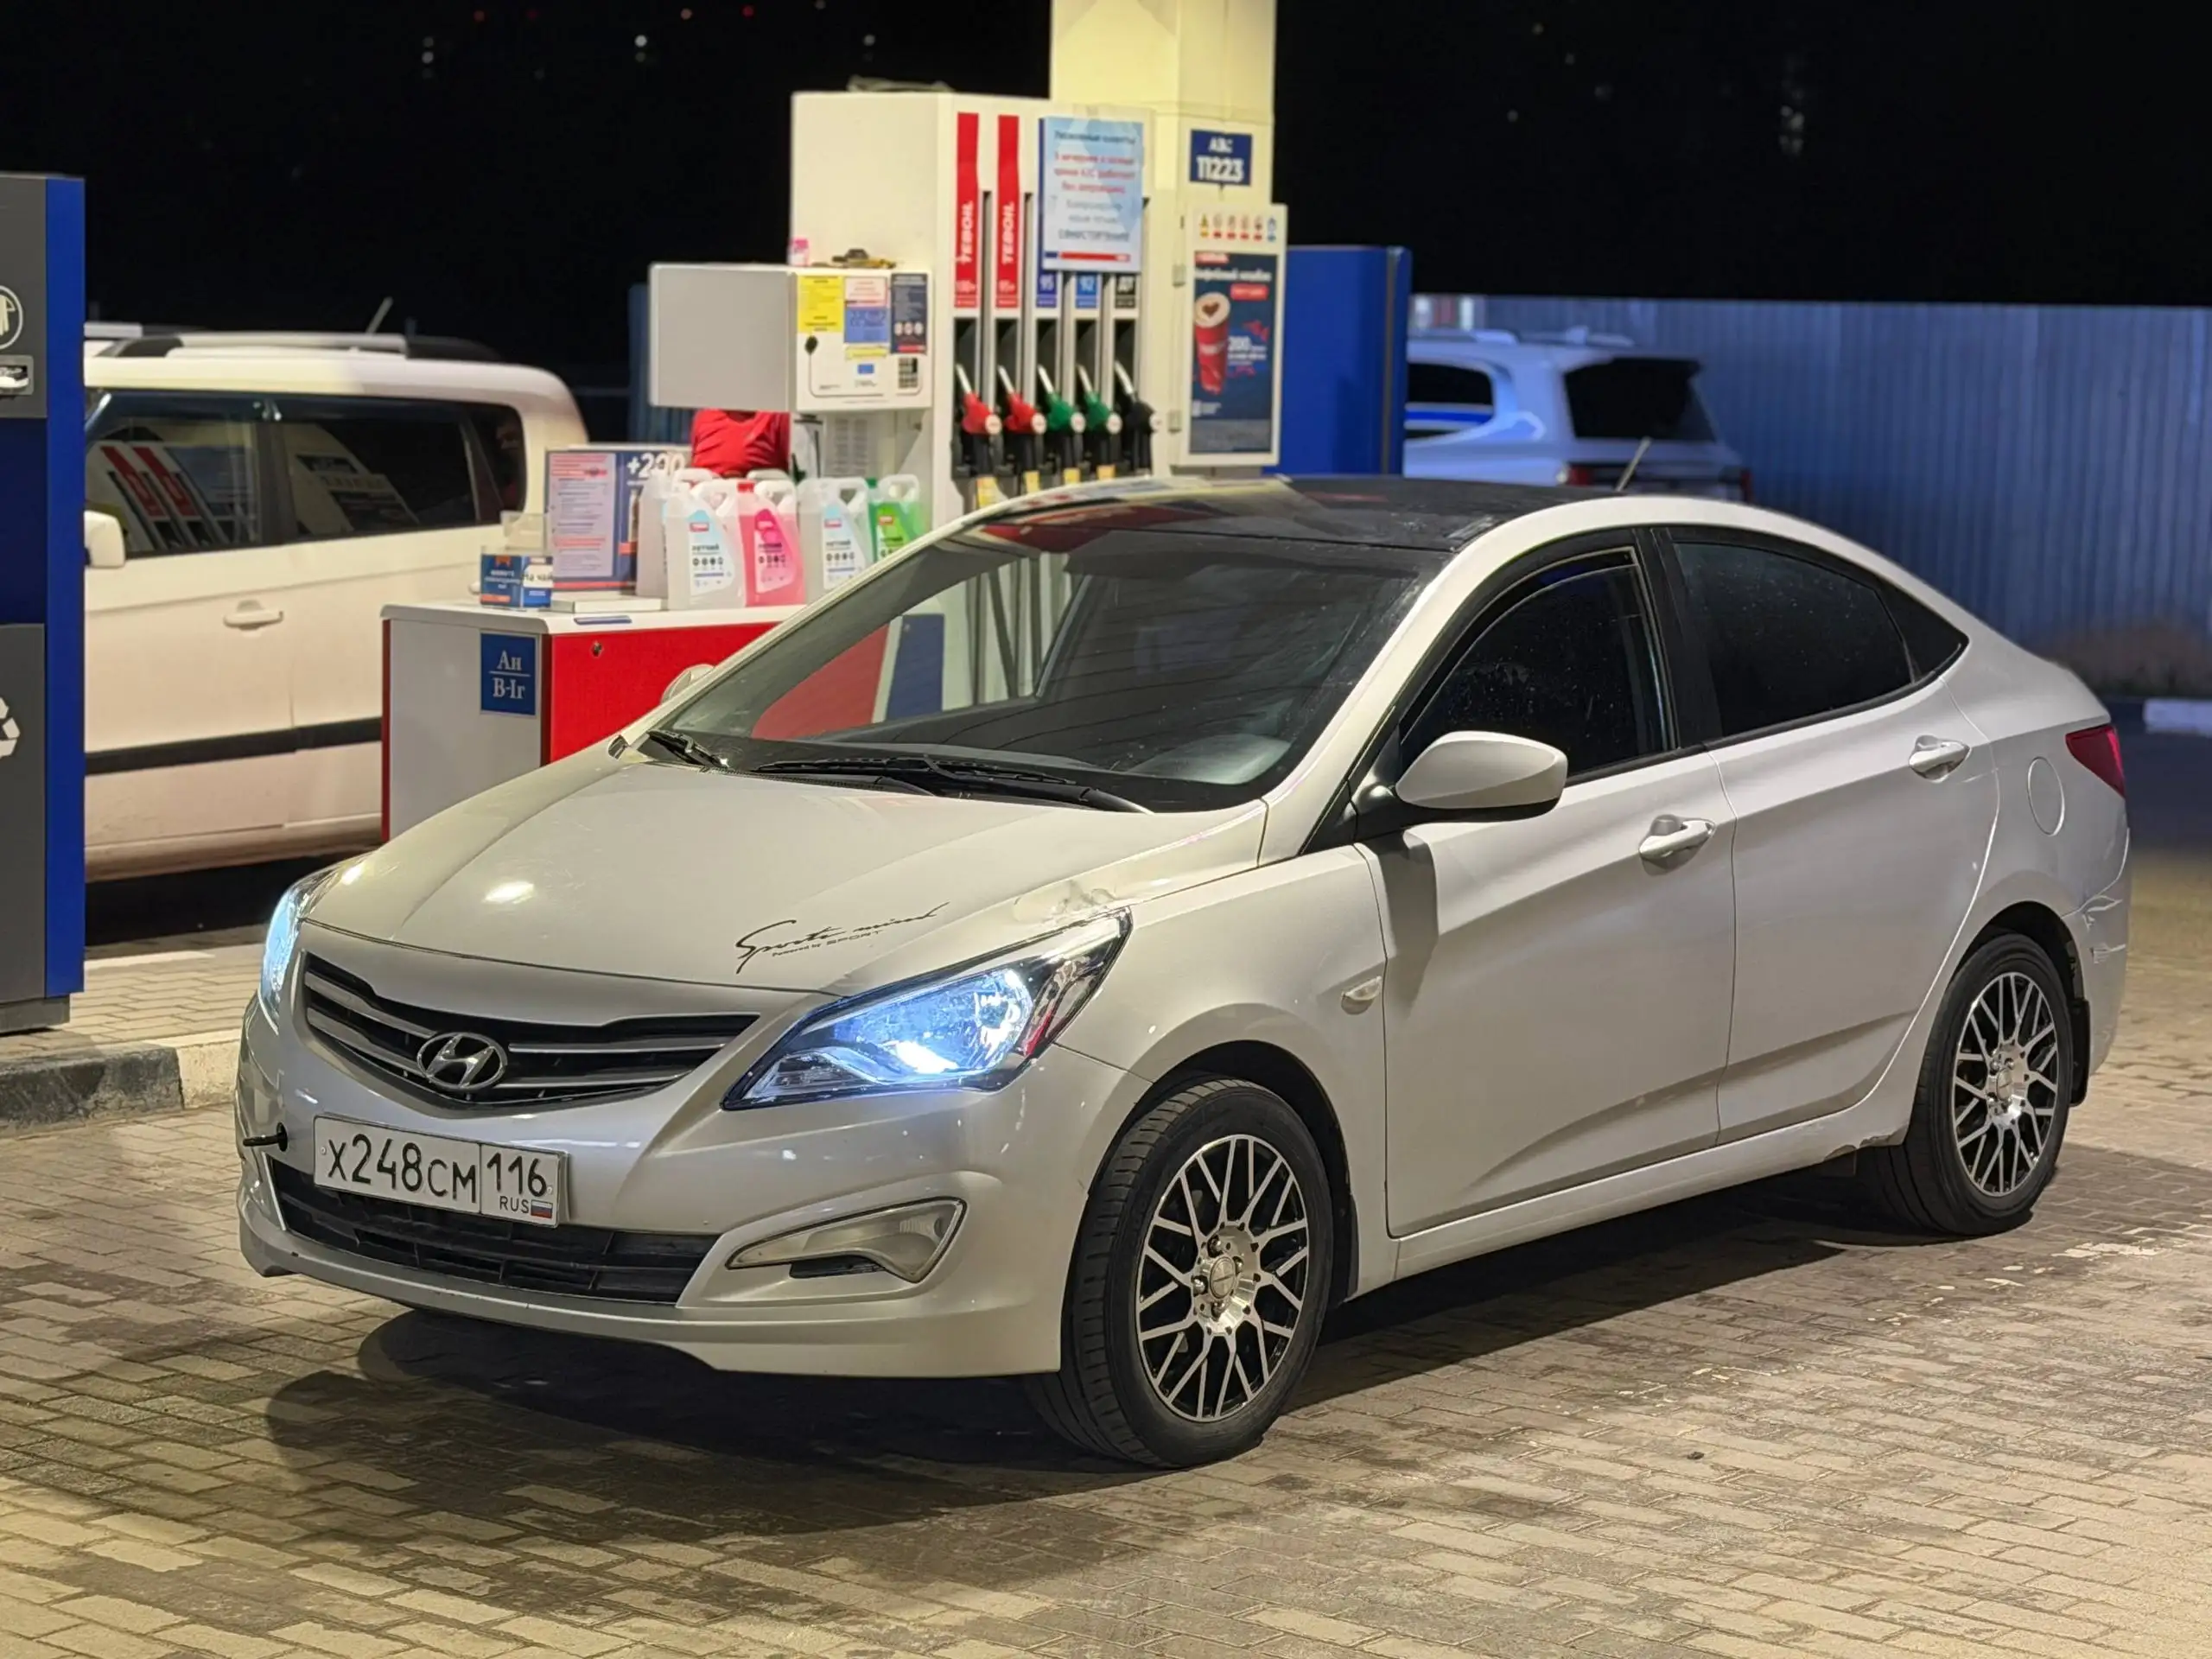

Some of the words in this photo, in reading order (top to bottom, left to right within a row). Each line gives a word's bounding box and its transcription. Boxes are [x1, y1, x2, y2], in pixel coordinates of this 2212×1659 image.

[1196, 156, 1244, 182] 11223
[961, 200, 974, 265] TEBOIL
[1002, 201, 1014, 265] TEBOIL
[486, 1152, 547, 1197] 116
[499, 1196, 530, 1215] RUS
